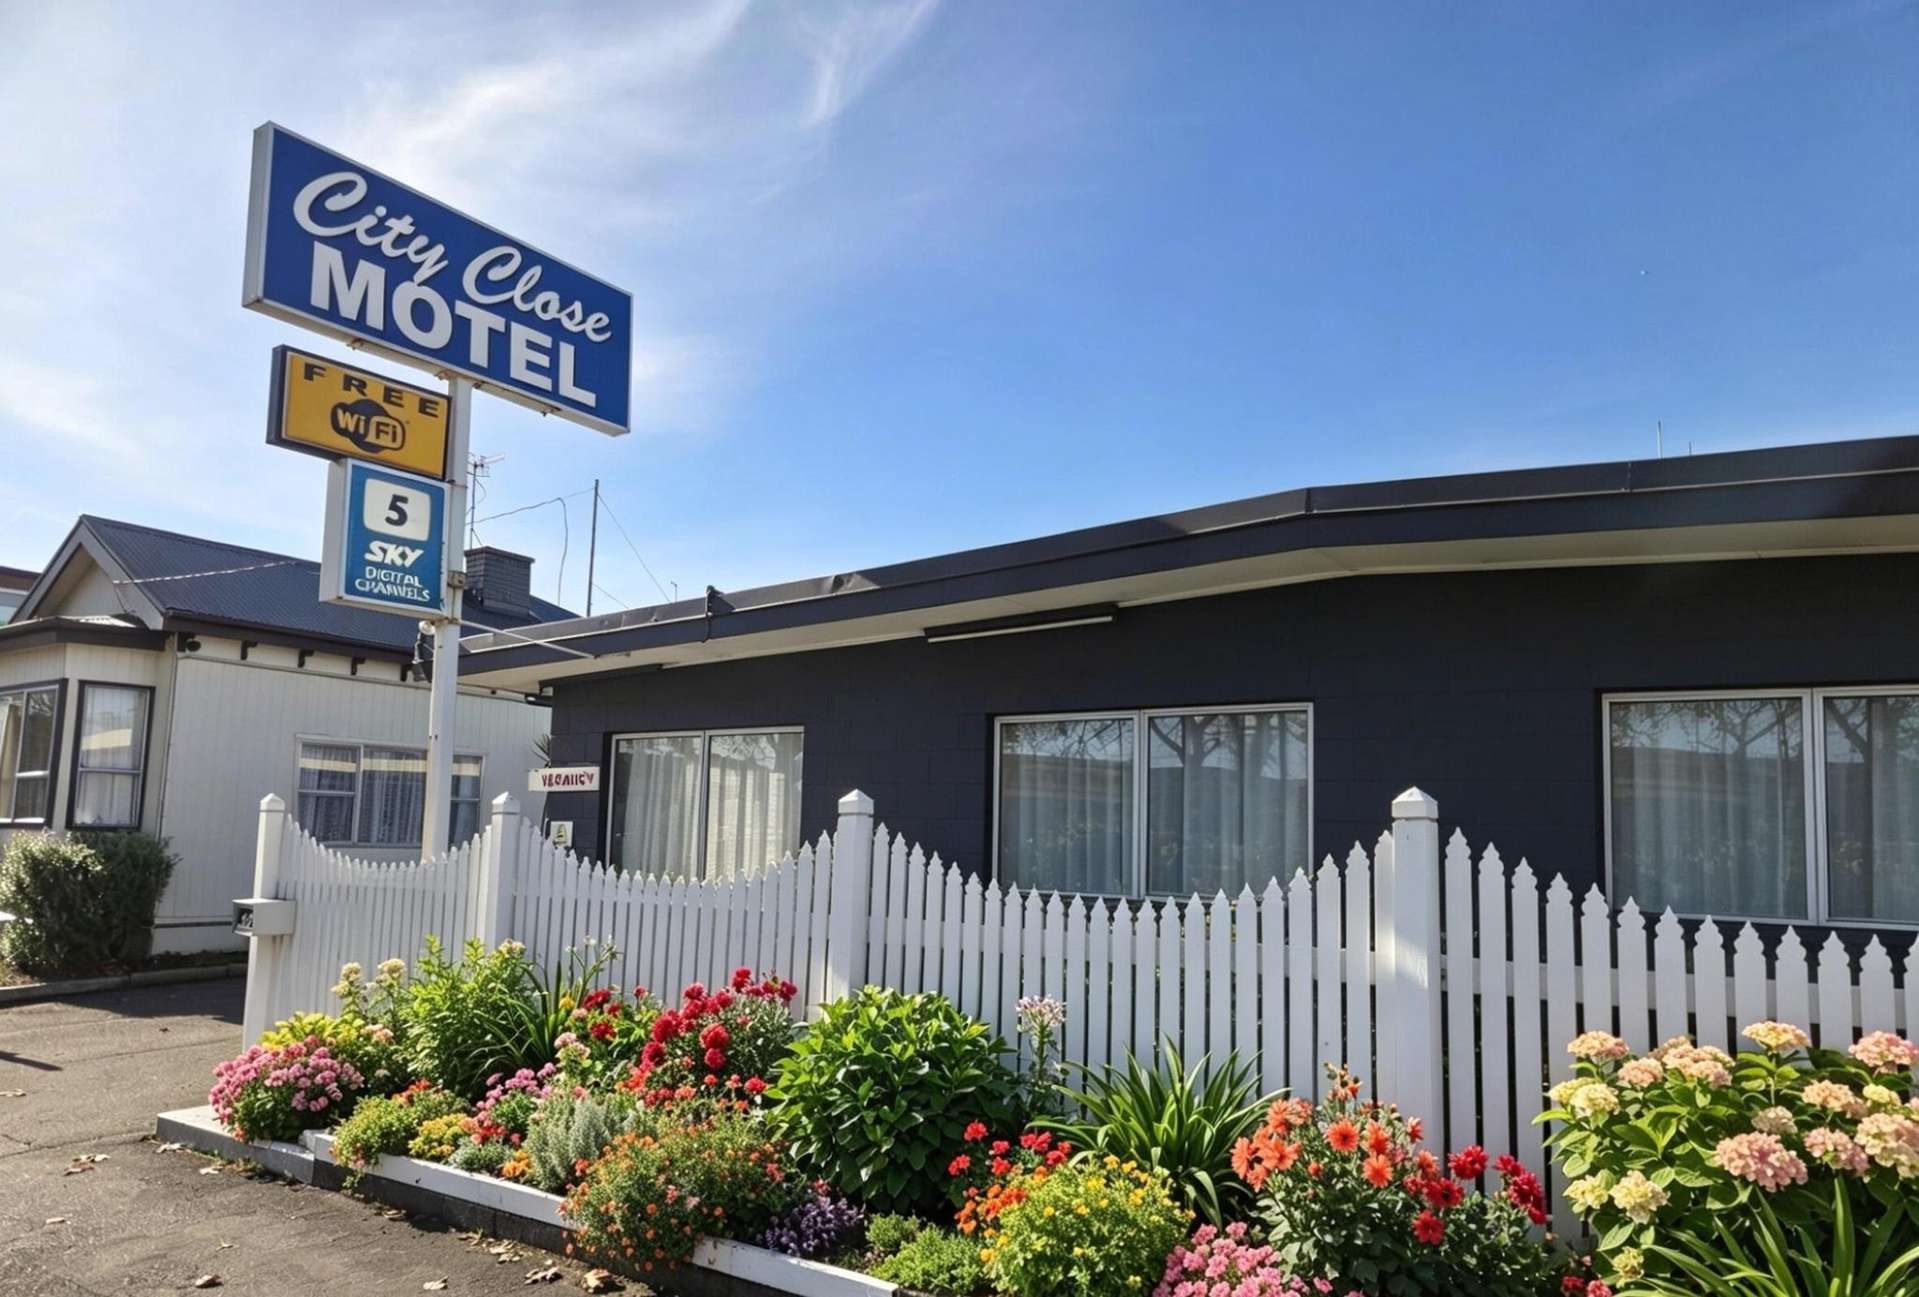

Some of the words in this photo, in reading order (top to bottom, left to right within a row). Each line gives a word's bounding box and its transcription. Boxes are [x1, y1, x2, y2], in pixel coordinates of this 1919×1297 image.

[293, 171, 449, 286] City
[462, 245, 612, 343] Close
[310, 240, 597, 408] MOTEL
[304, 362, 440, 419] FREE
[385, 493, 409, 527] 5
[364, 540, 424, 568] SKY
[365, 566, 423, 589] DIGITAL
